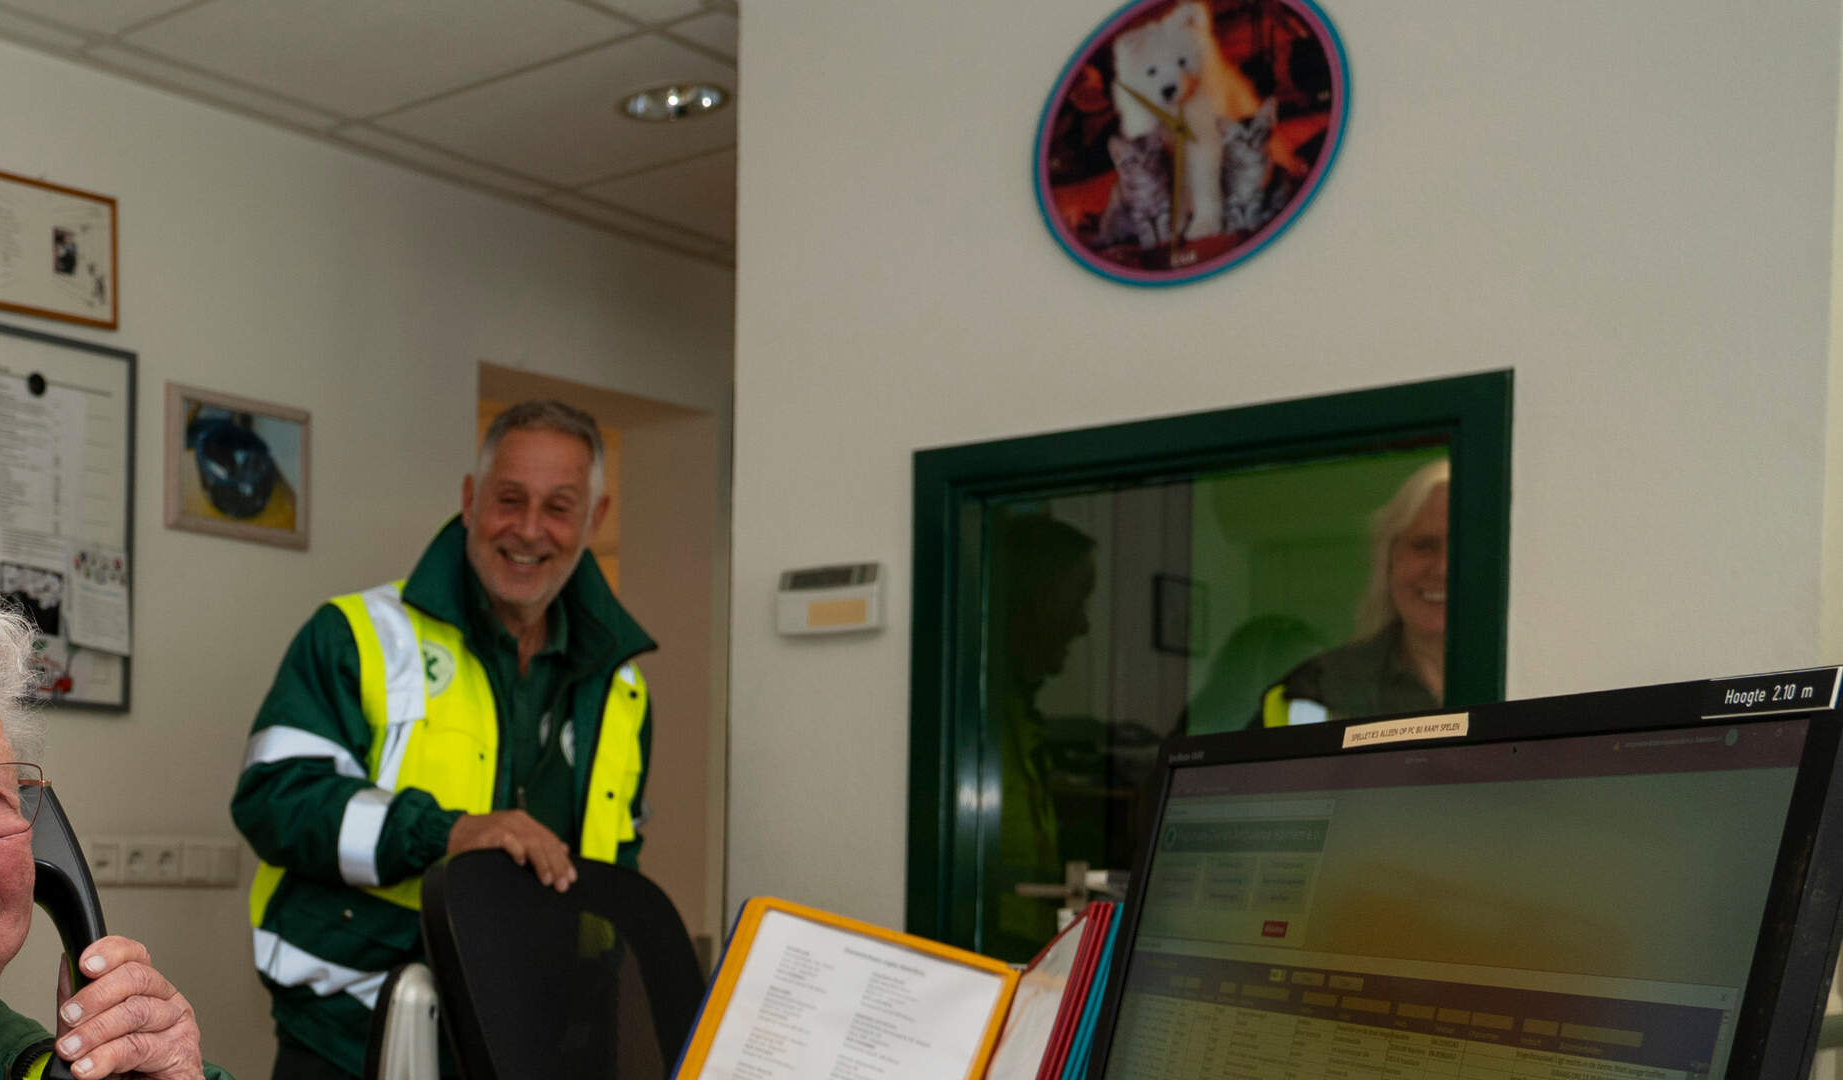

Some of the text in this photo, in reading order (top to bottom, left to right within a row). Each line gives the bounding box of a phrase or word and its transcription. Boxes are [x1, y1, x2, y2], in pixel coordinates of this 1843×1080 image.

[1724, 683, 1814, 707] Hoogte 2.10 m
